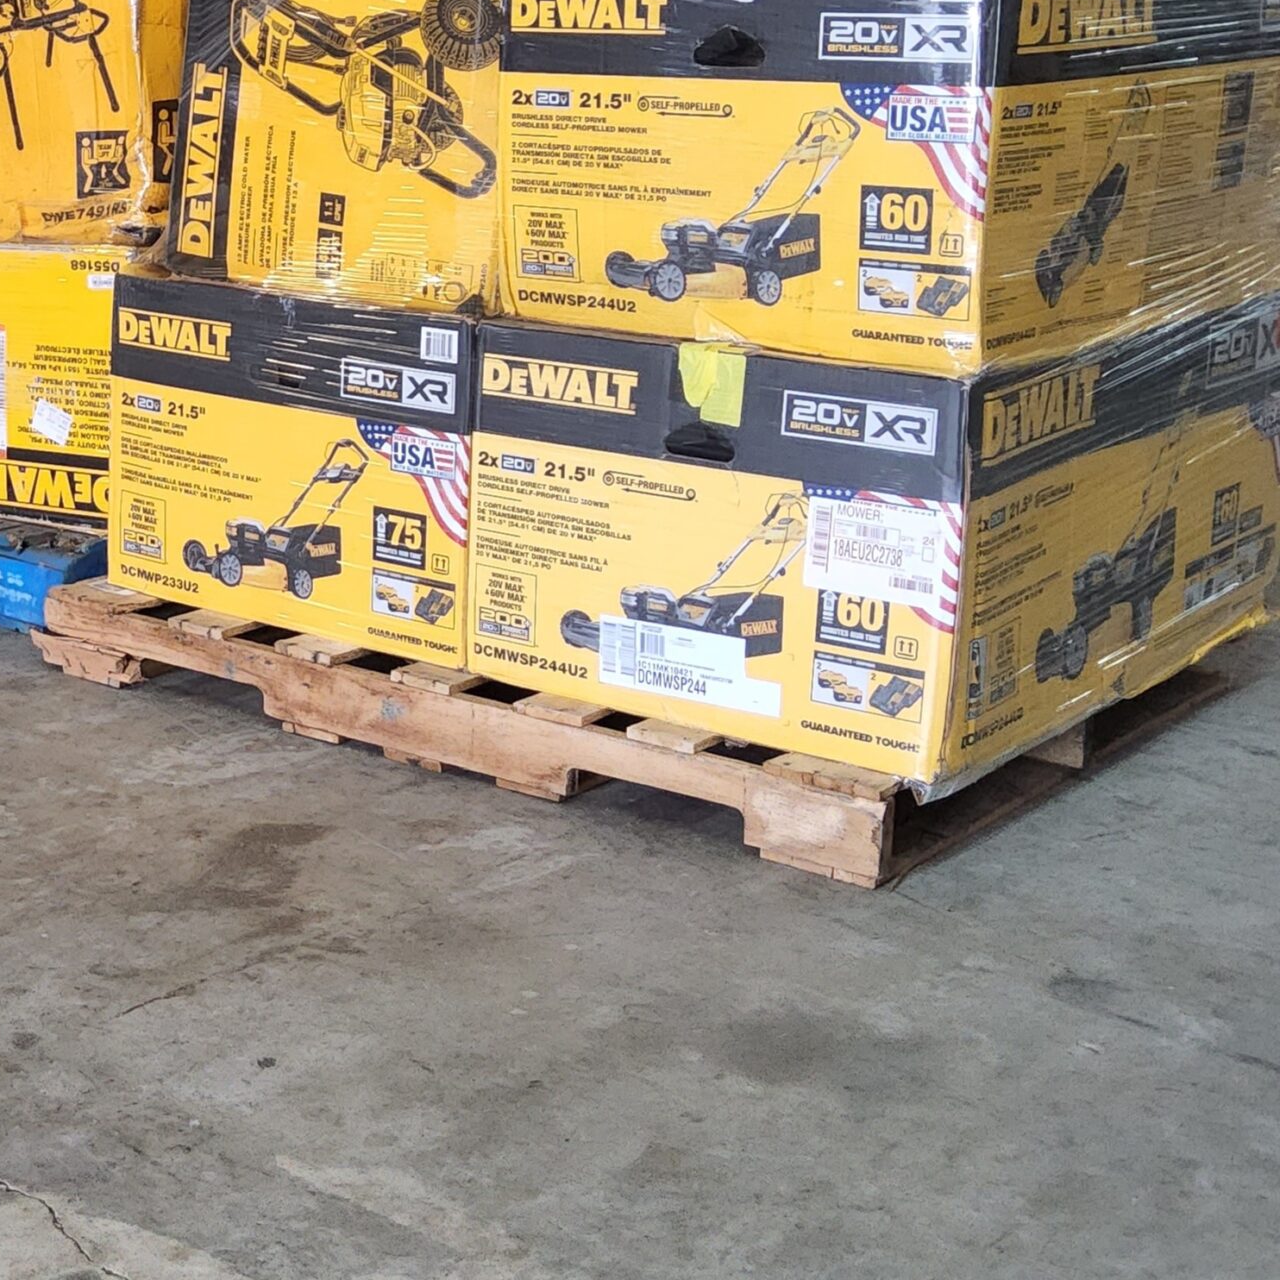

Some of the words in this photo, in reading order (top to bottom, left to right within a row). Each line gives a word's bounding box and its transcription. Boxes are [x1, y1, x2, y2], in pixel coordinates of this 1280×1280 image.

[828, 44, 898, 53] BRUSHLESS
[909, 24, 968, 52] XR
[512, 89, 533, 106] 2x
[651, 100, 720, 111] SELF-PROPELLED
[891, 96, 913, 104] MADE
[890, 105, 947, 132] USA
[181, 64, 223, 257] DEWALT
[880, 193, 928, 231] 60
[71, 260, 120, 272] D55168
[518, 290, 636, 312] DCMWSP244U2
[120, 313, 231, 357] DEWALT
[852, 329, 925, 345] GUARANTEED
[34, 354, 87, 364] COMPRESSEUR
[346, 385, 399, 400] BRUSHLESS
[406, 375, 449, 404] XR
[483, 357, 639, 411] DEWALT
[122, 392, 136, 407] 2x
[871, 410, 928, 445] XR
[982, 370, 1103, 460] DEWALT
[80, 431, 109, 441] GALLON
[789, 421, 860, 438] BRUSHLESS
[393, 441, 436, 470] USA
[478, 451, 499, 468] 2x
[616, 476, 684, 495] SELF-PROPELLED
[388, 514, 422, 550] 75
[121, 564, 199, 593] DCMWP233U2
[837, 593, 884, 631] 60
[368, 626, 422, 648] GUARANTEED
[473, 642, 588, 679] DCMWSP244U2
[638, 669, 707, 696] DCMWSP244
[801, 720, 872, 743] GUARANTEED
